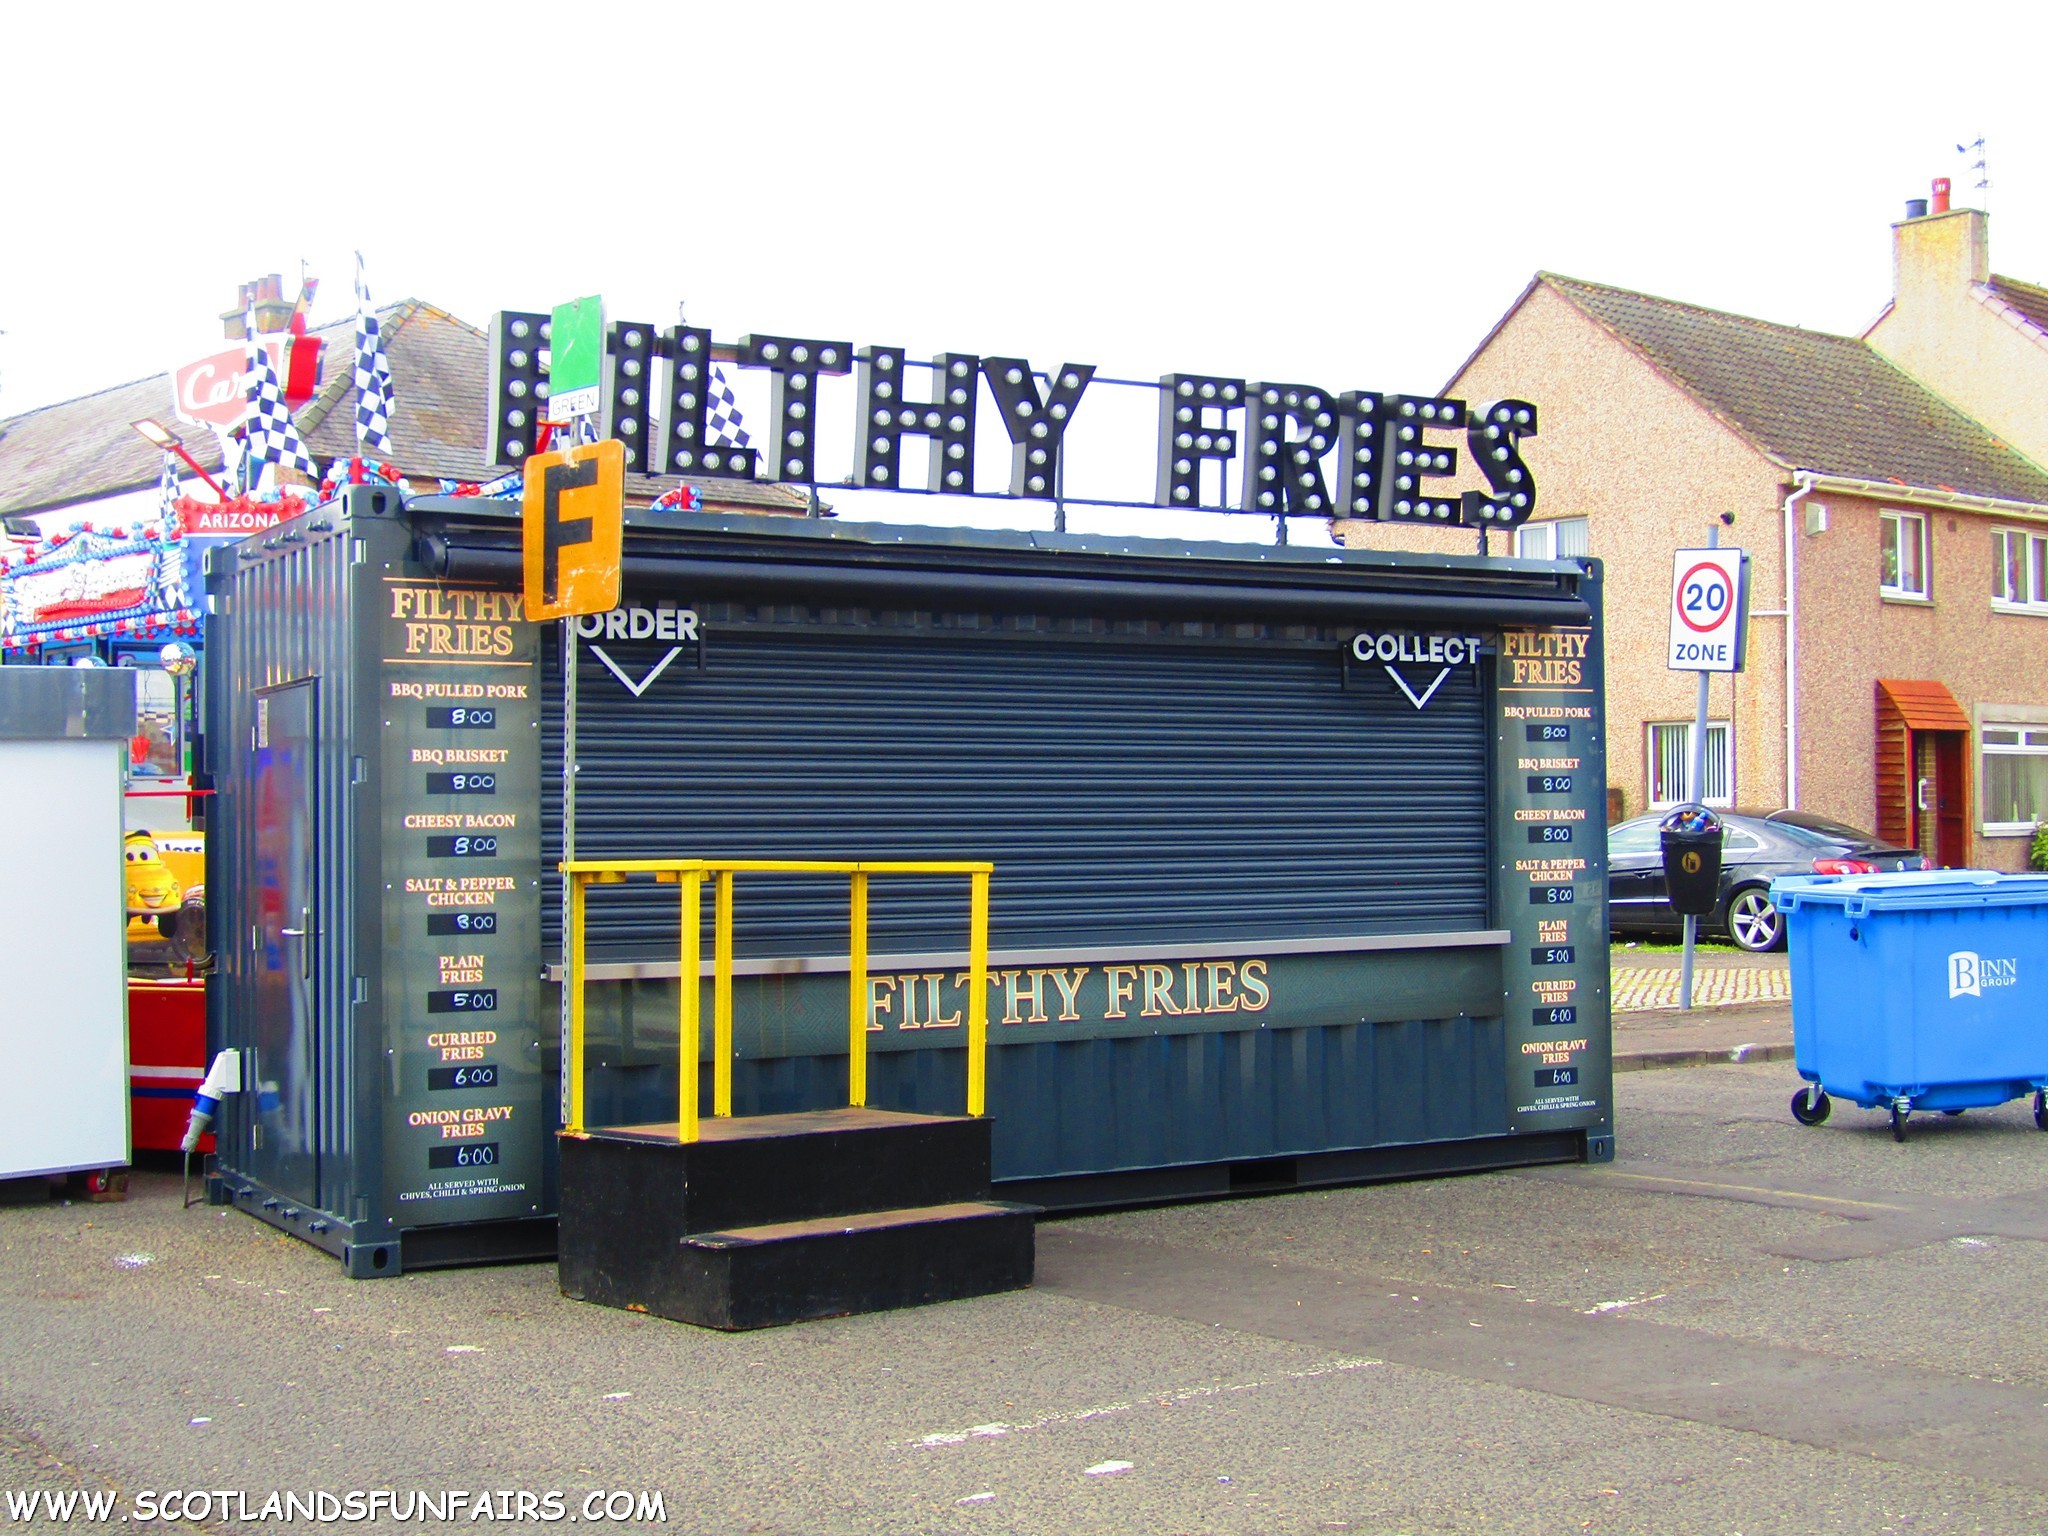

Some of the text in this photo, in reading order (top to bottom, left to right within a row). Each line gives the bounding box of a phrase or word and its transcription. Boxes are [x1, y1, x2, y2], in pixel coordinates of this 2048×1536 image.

[552, 392, 596, 415] GREEN
[486, 311, 1538, 526] FILTHY FRIES
[199, 512, 281, 529] ARIZONA
[543, 457, 598, 605] F
[391, 587, 525, 621] FILTHY
[1686, 583, 1725, 611] 20
[576, 608, 699, 640] ORDER
[405, 623, 514, 656] FRIES
[1504, 632, 1590, 657] FILTHY
[1353, 633, 1480, 664] COLLECT
[1676, 644, 1727, 661] ZONE
[1513, 660, 1582, 684] FRIES
[391, 683, 527, 699] BBQ PULLED PORK
[1504, 707, 1591, 718] BBQ PULLED PORK
[411, 749, 508, 763] BBQ BRISKET
[1518, 758, 1580, 770] BBQ BRISKET
[404, 814, 516, 828] CHEESY BACON
[1514, 810, 1585, 820] CHEESY BACON
[1516, 859, 1586, 870] SALT & PEPPER
[1529, 871, 1573, 881] CHICKEN
[405, 877, 515, 892] SALT & PEPPER
[426, 891, 496, 906] CHICKEN
[1538, 920, 1567, 931] PLAIN
[1539, 931, 1567, 942] FRIES
[439, 955, 485, 970] PLAIN
[440, 969, 484, 984] FRIES
[1953, 957, 2017, 990] BINN
[1103, 960, 1270, 1019] FRIES
[1532, 981, 1576, 992] CURRIED
[1980, 977, 2016, 987] GROUP
[1541, 993, 1568, 1004] FRIES
[427, 1031, 497, 1047] CURRIED
[1521, 1039, 1587, 1054] ONION GRAVY
[441, 1046, 485, 1061] FRIES
[1542, 1052, 1570, 1064] FRIES
[409, 1106, 514, 1126] ONION GRAVY
[441, 1122, 485, 1138] FRIES
[444, 1180, 476, 1188] SERVED
[477, 1178, 499, 1186] WITH
[400, 1191, 432, 1201] CHIVES,
[433, 1189, 460, 1197] CHILLI
[469, 1184, 498, 1194] SPRING
[499, 1183, 526, 1191] ONION
